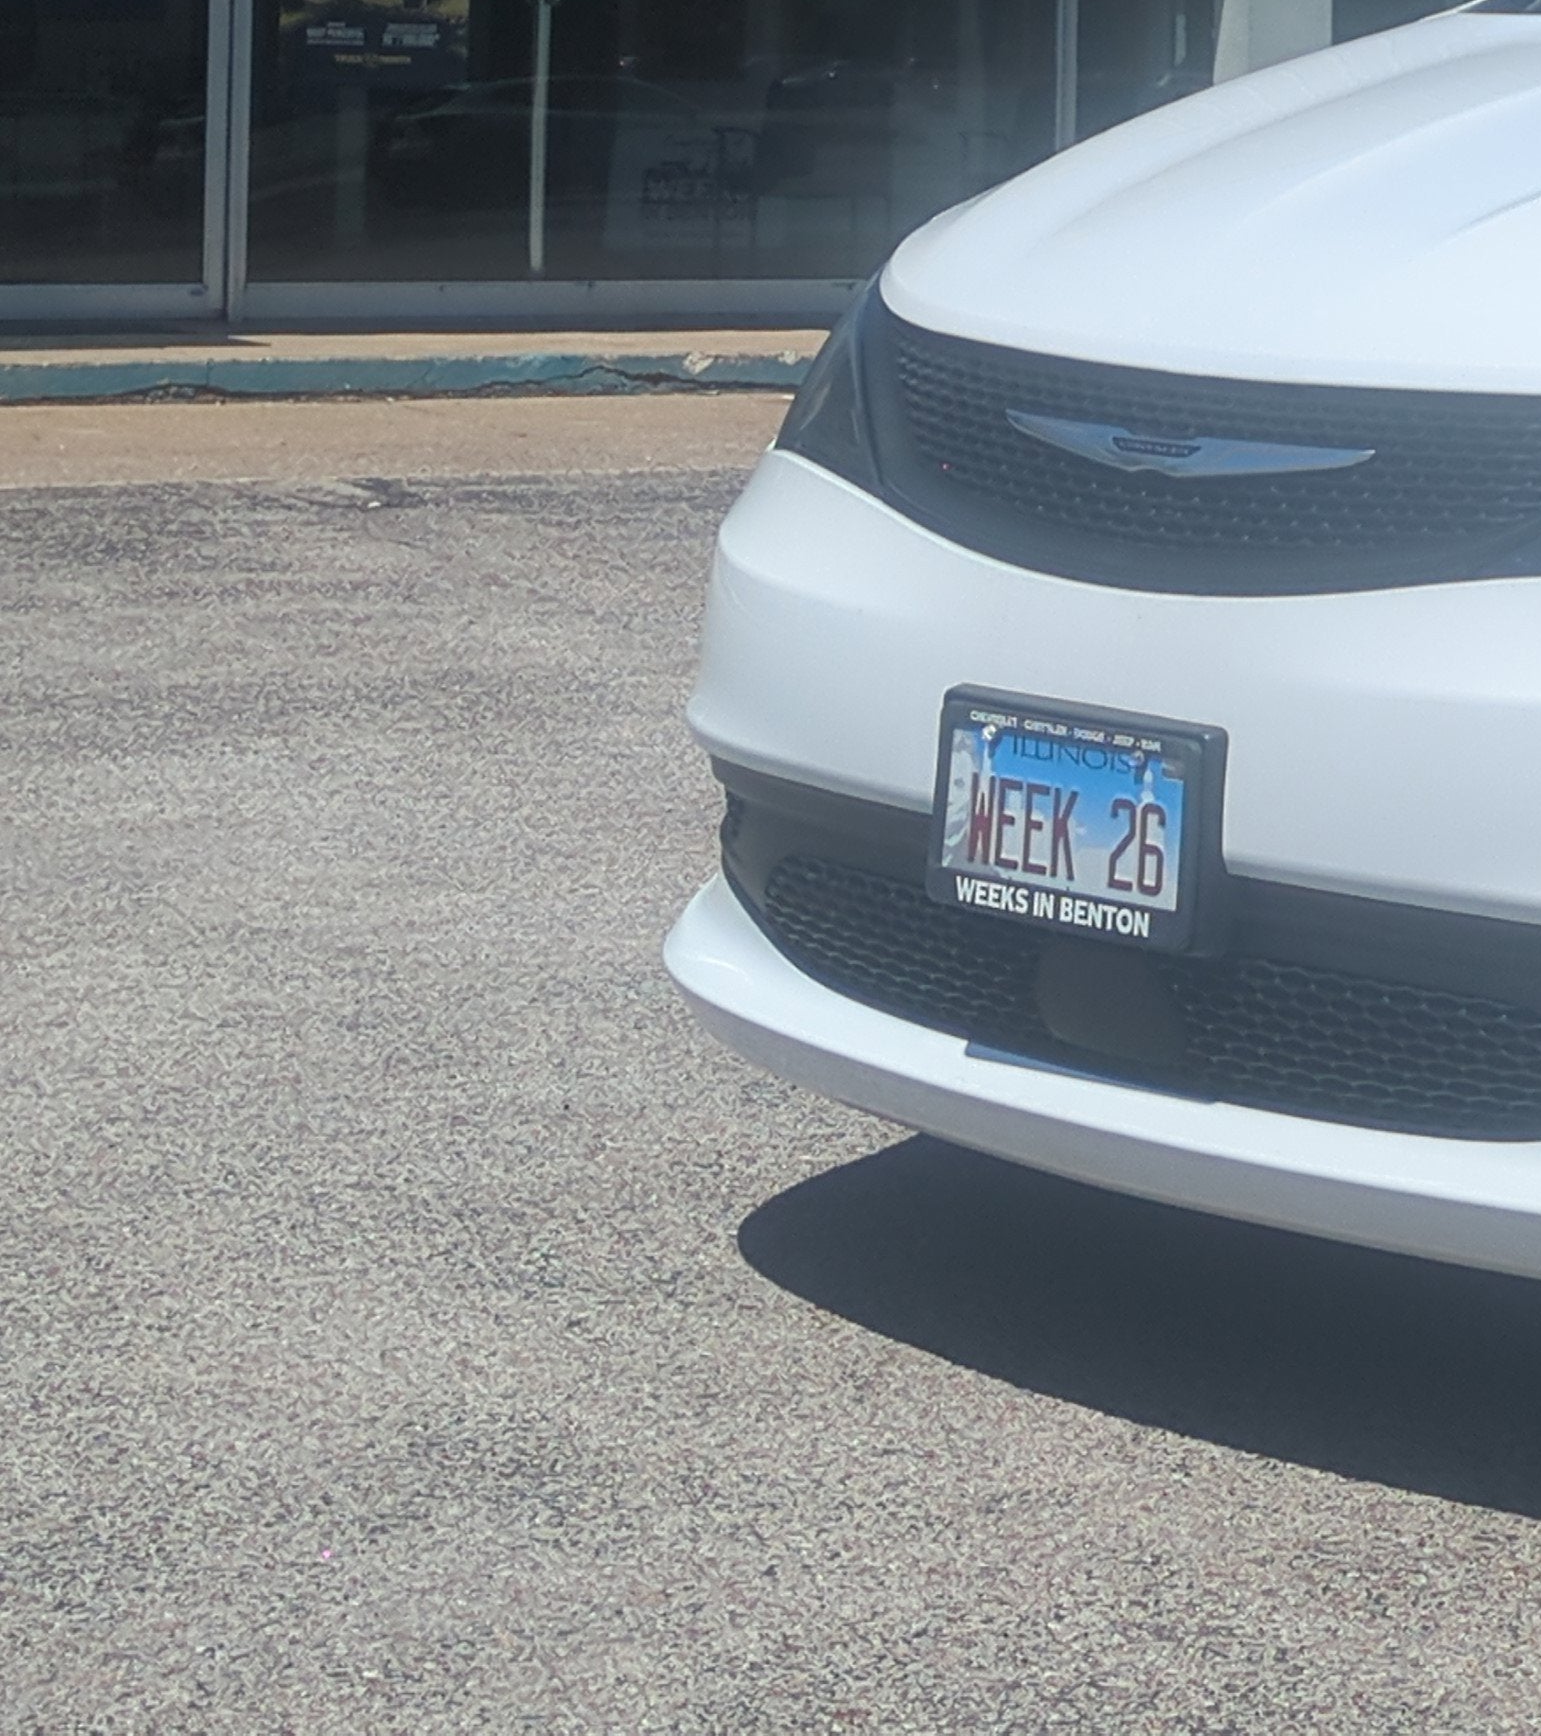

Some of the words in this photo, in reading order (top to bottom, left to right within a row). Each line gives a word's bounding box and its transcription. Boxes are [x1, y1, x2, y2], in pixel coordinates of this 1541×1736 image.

[967, 772, 1078, 881] WEEK
[1107, 798, 1167, 897] 26
[956, 876, 1029, 914] WEEKS
[1033, 891, 1055, 920] IN
[1059, 896, 1149, 937] BENTON
